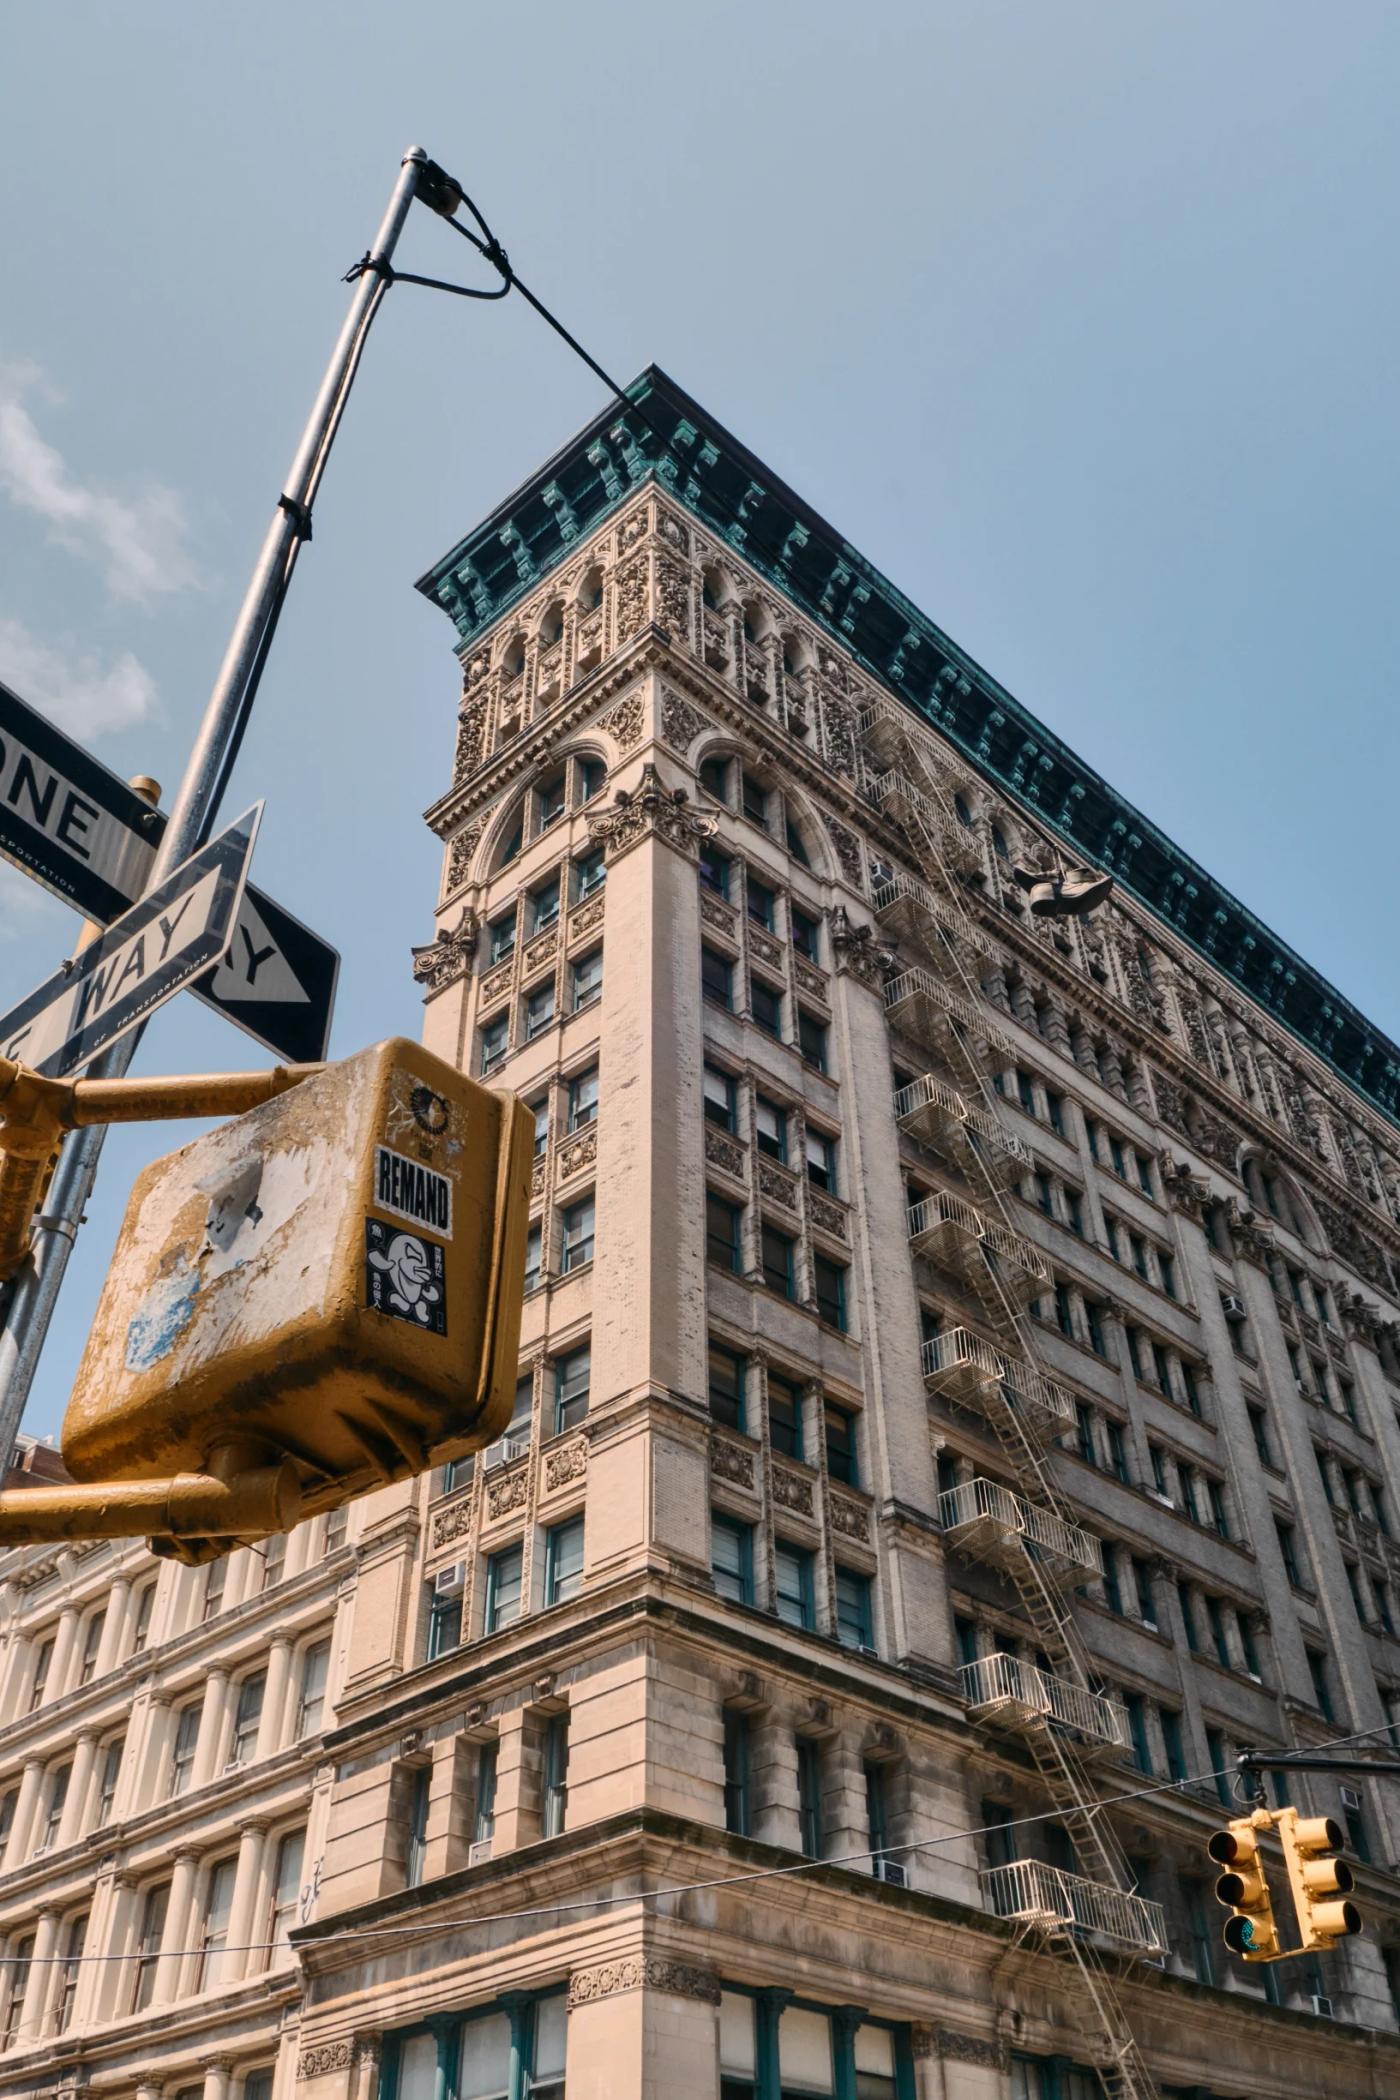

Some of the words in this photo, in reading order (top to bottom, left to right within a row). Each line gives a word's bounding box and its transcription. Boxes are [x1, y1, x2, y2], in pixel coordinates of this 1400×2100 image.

[0, 735, 99, 860] NE
[75, 893, 195, 1031] WAY
[117, 953, 208, 1029] TRANSPORTATION
[224, 924, 277, 986] Y
[379, 1150, 449, 1230] REMAND
